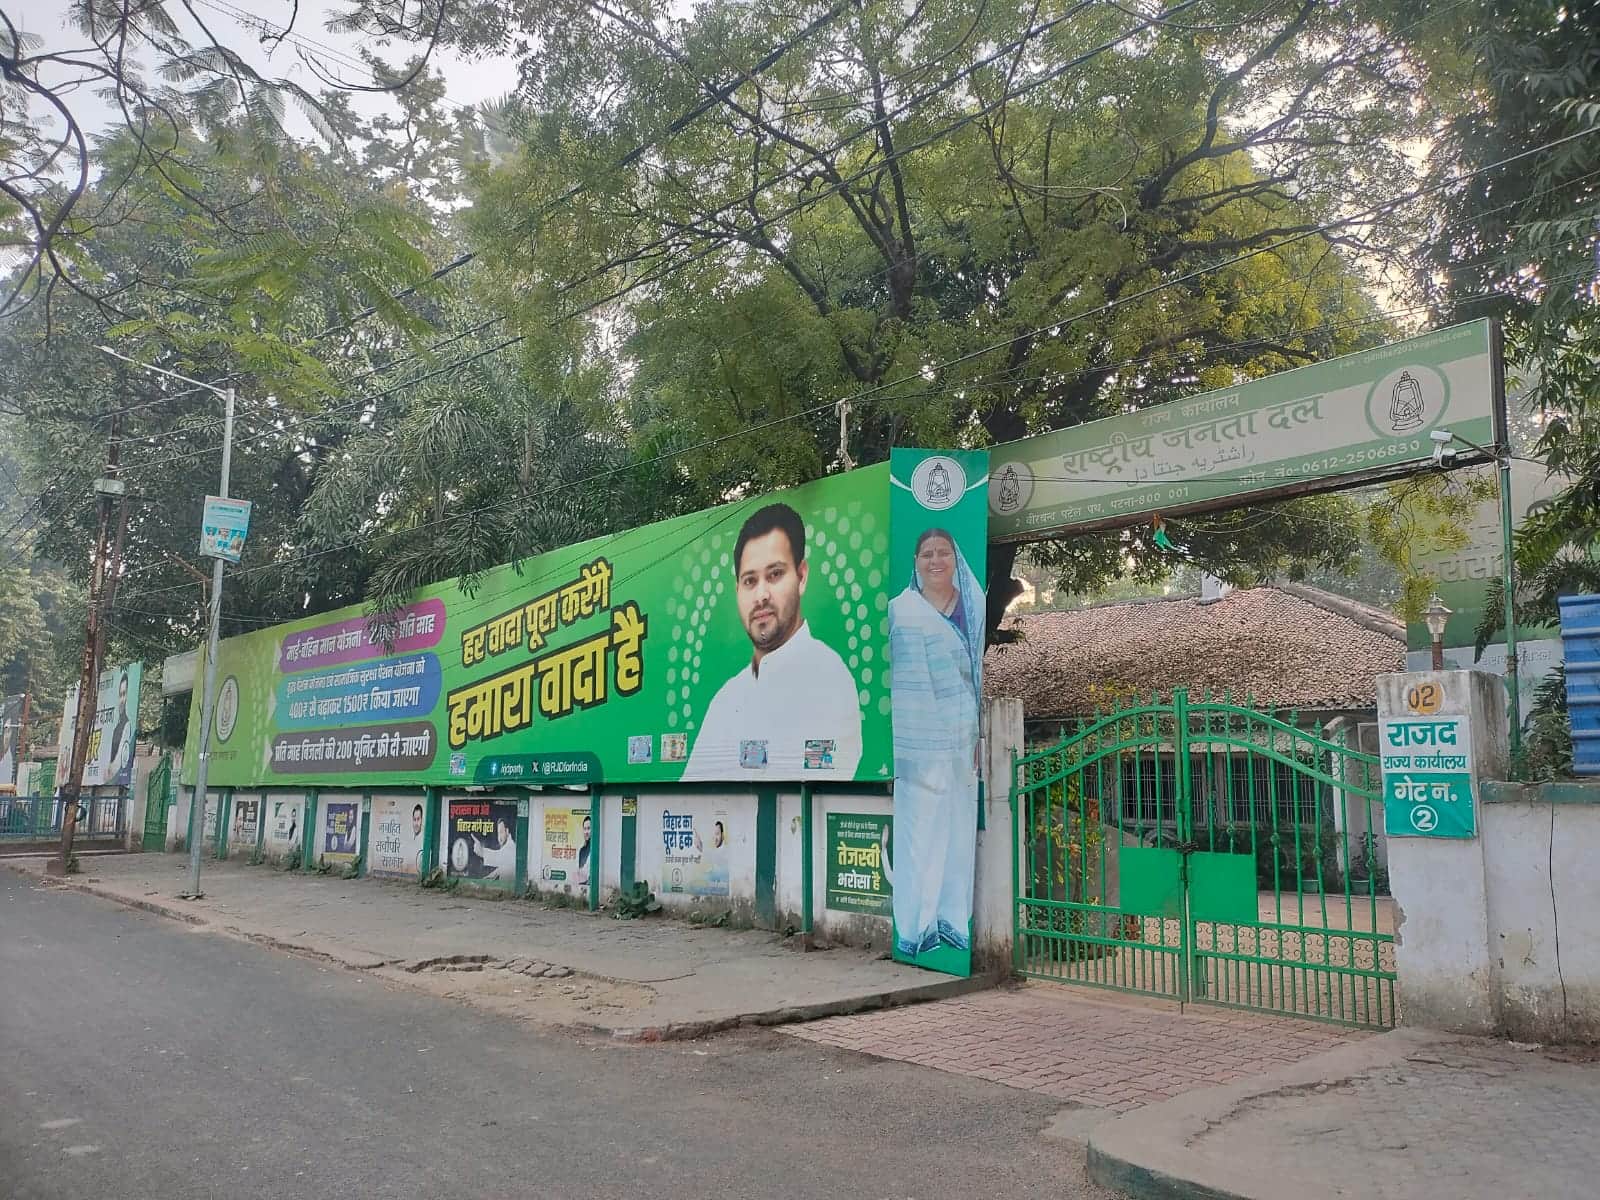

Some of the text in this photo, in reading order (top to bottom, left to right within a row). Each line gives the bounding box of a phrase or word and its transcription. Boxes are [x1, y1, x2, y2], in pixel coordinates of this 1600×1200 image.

[1181, 392, 1240, 417] कार्यालय
[1062, 393, 1326, 476] राष्ट्रीय जनता दल
[1168, 487, 1189, 499] 001
[416, 613, 436, 634] माह
[462, 558, 613, 666] हर वादा पूरा करेंगे
[447, 603, 648, 748] हमारा वादा है
[309, 696, 317, 717] से
[369, 686, 391, 709] किया
[392, 686, 421, 707] जाएगा
[1408, 685, 1435, 711] 02
[275, 729, 430, 765] प्रति माह बिजली की 200 यूनिट फ्री दी जाएगी
[1386, 721, 1459, 747] राजद
[1384, 750, 1467, 770] राज्य कार्यालय
[1394, 774, 1431, 803] गेट
[663, 809, 693, 830] बिहार का
[1415, 810, 1434, 830] 2
[663, 830, 678, 855] पूरा
[837, 840, 881, 869] तेजस्वी
[837, 869, 881, 891] भरोसा है
